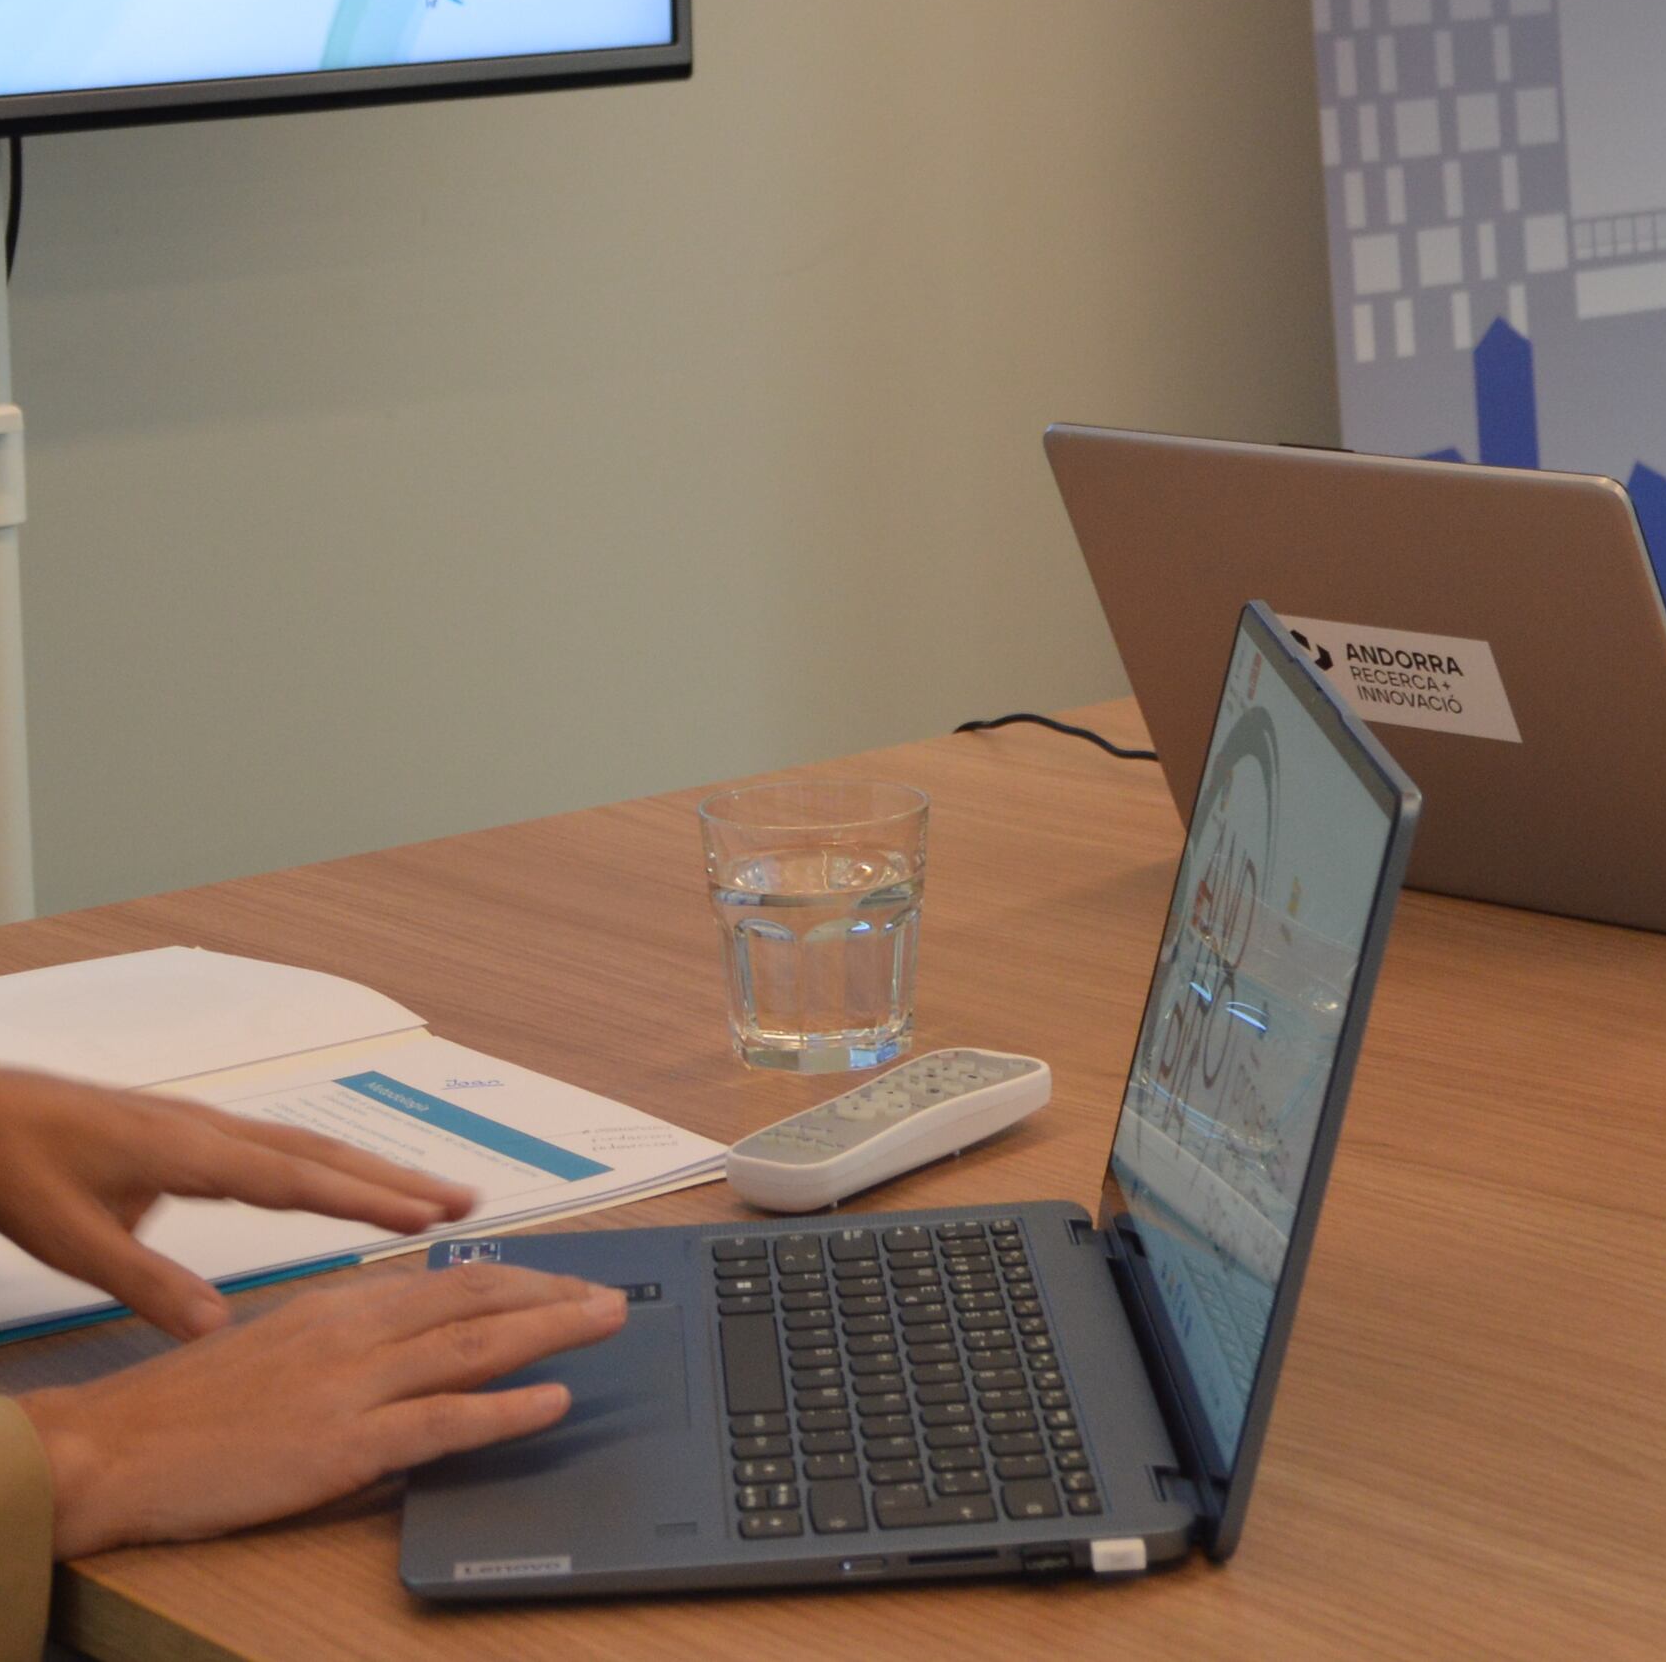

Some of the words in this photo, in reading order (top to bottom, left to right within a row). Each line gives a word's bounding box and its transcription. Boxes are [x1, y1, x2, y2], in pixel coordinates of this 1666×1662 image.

[1345, 643, 1464, 677] ANDORRA
[1350, 665, 1441, 690] RECERCA
[1357, 685, 1463, 714] INNOVACIÓ
